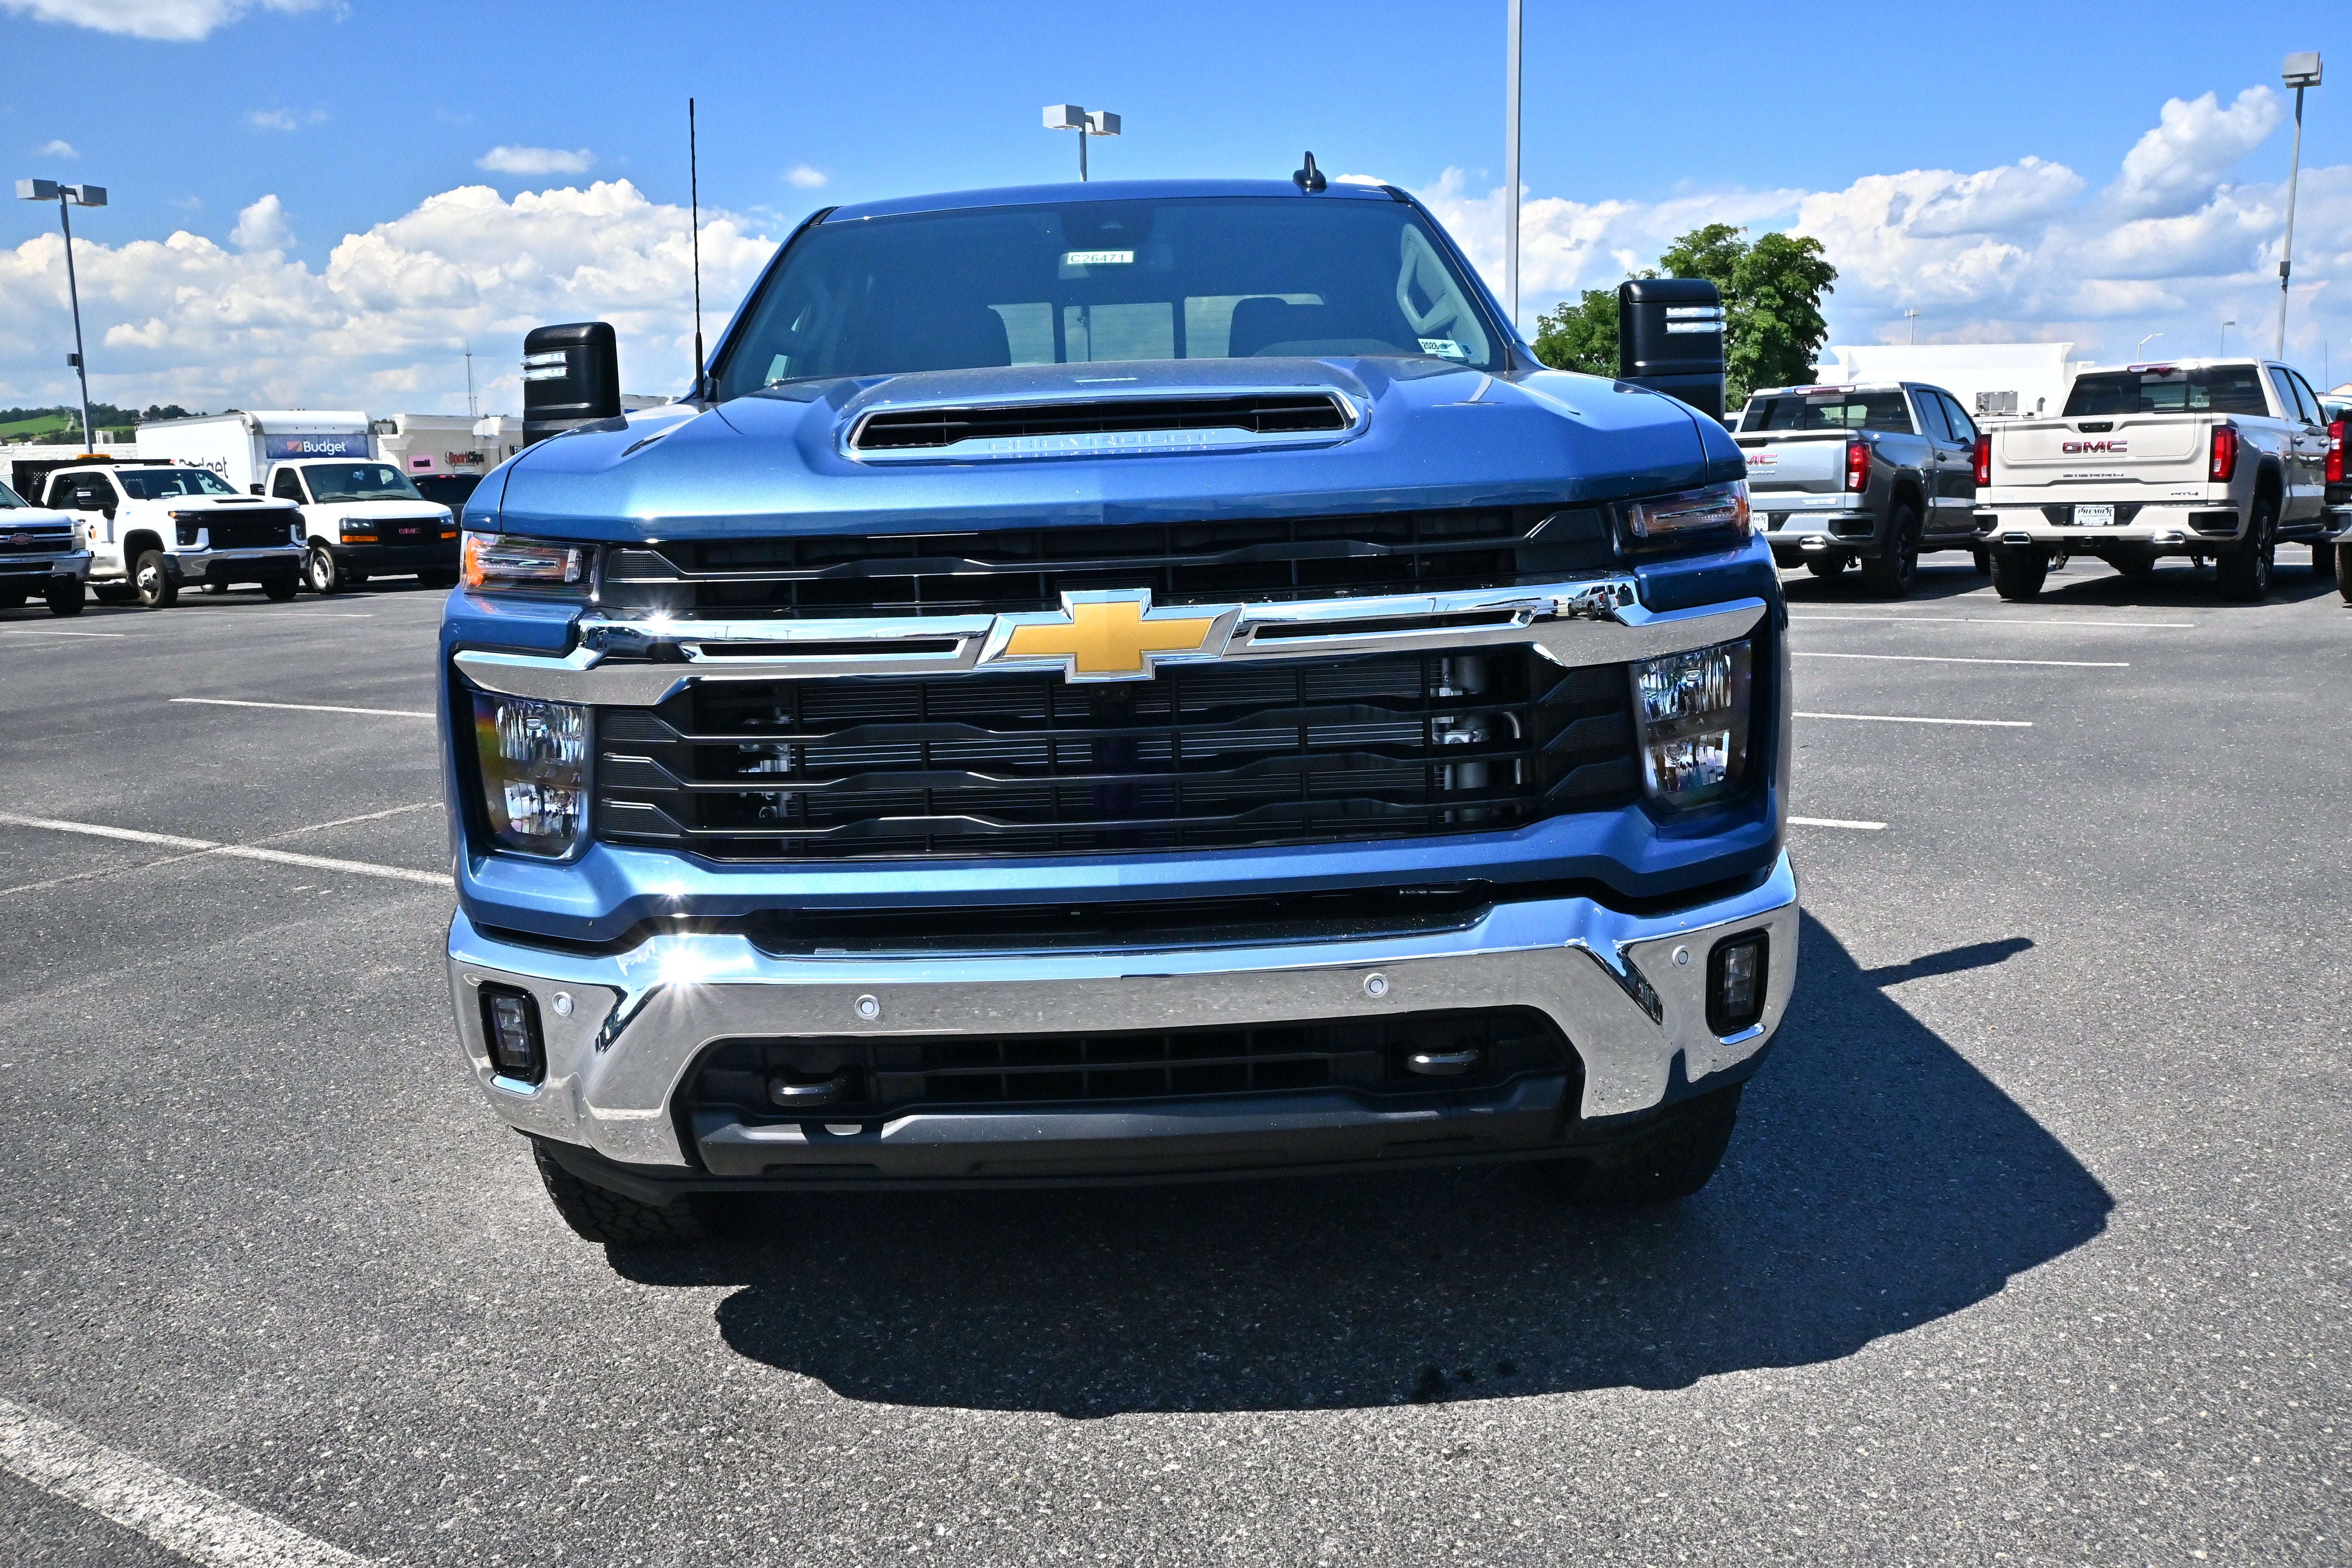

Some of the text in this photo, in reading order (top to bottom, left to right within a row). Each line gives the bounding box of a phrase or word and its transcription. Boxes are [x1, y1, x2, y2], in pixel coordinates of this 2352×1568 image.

[1071, 254, 1124, 262] C26471
[1421, 342, 1439, 350] 2028
[1462, 345, 1472, 354] 8
[303, 441, 346, 455] Budget
[2062, 440, 2128, 454] GMC
[1747, 453, 1778, 465] MC
[2078, 508, 2112, 516] PREMIER
